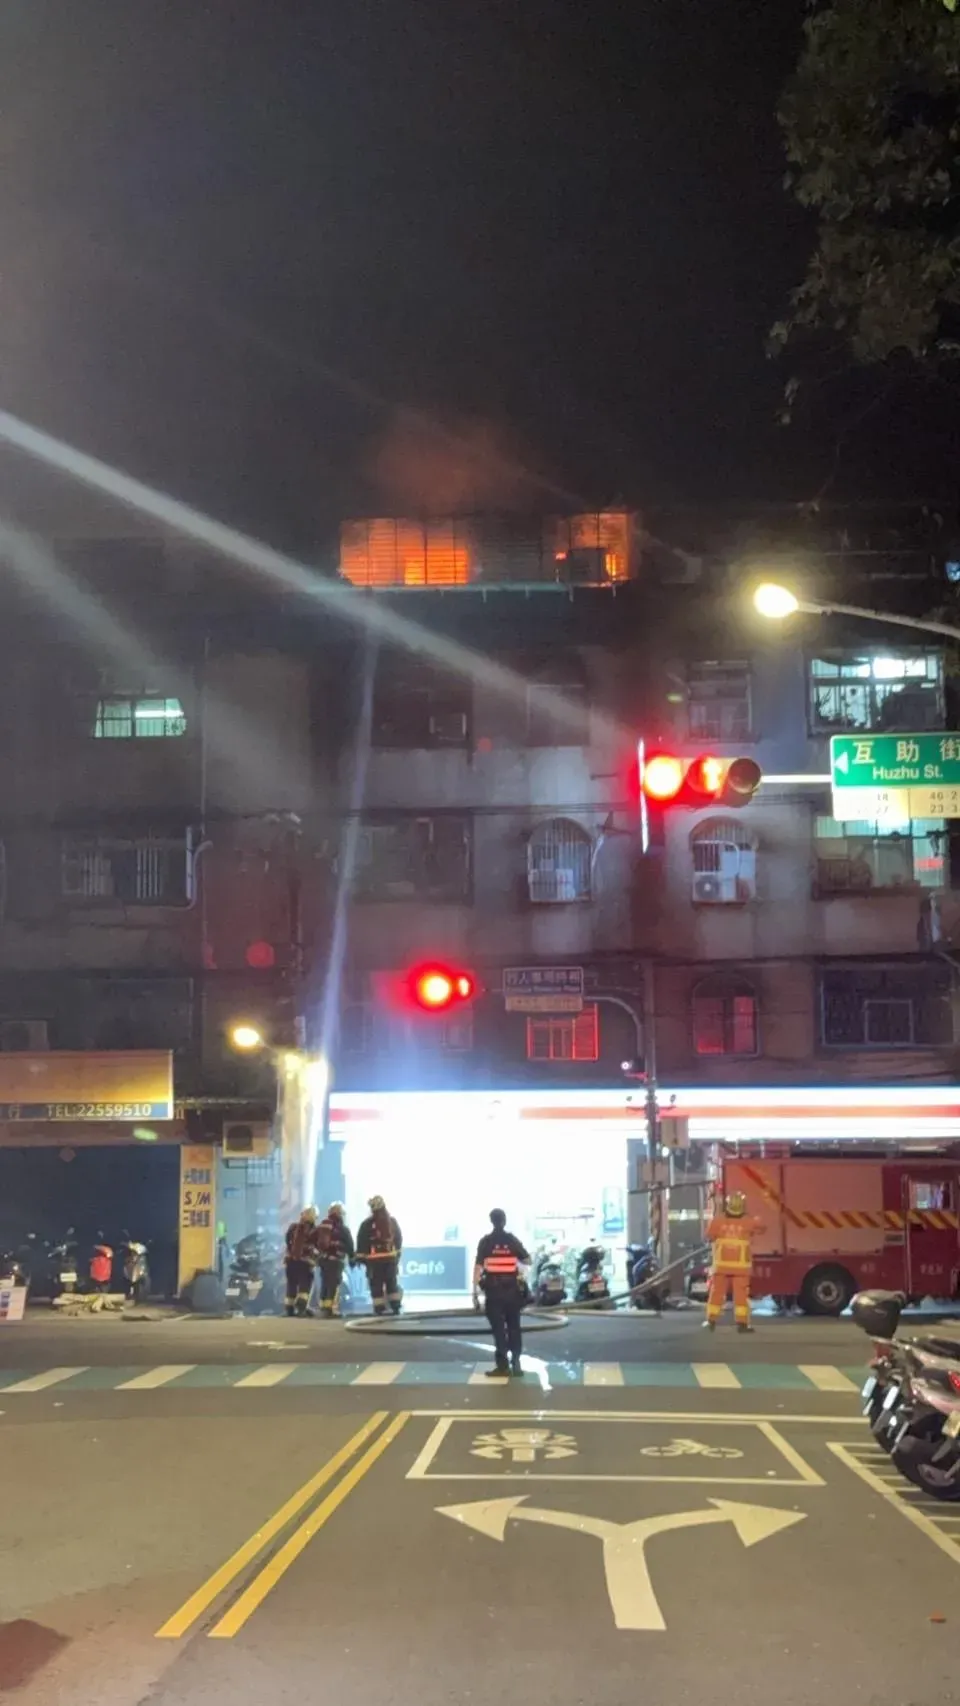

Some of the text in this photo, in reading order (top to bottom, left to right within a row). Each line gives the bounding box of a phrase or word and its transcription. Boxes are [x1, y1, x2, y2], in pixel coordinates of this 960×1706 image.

[852, 738, 960, 765] 互助街
[873, 763, 944, 780] Huzhu St.
[406, 1260, 445, 1275] Café
